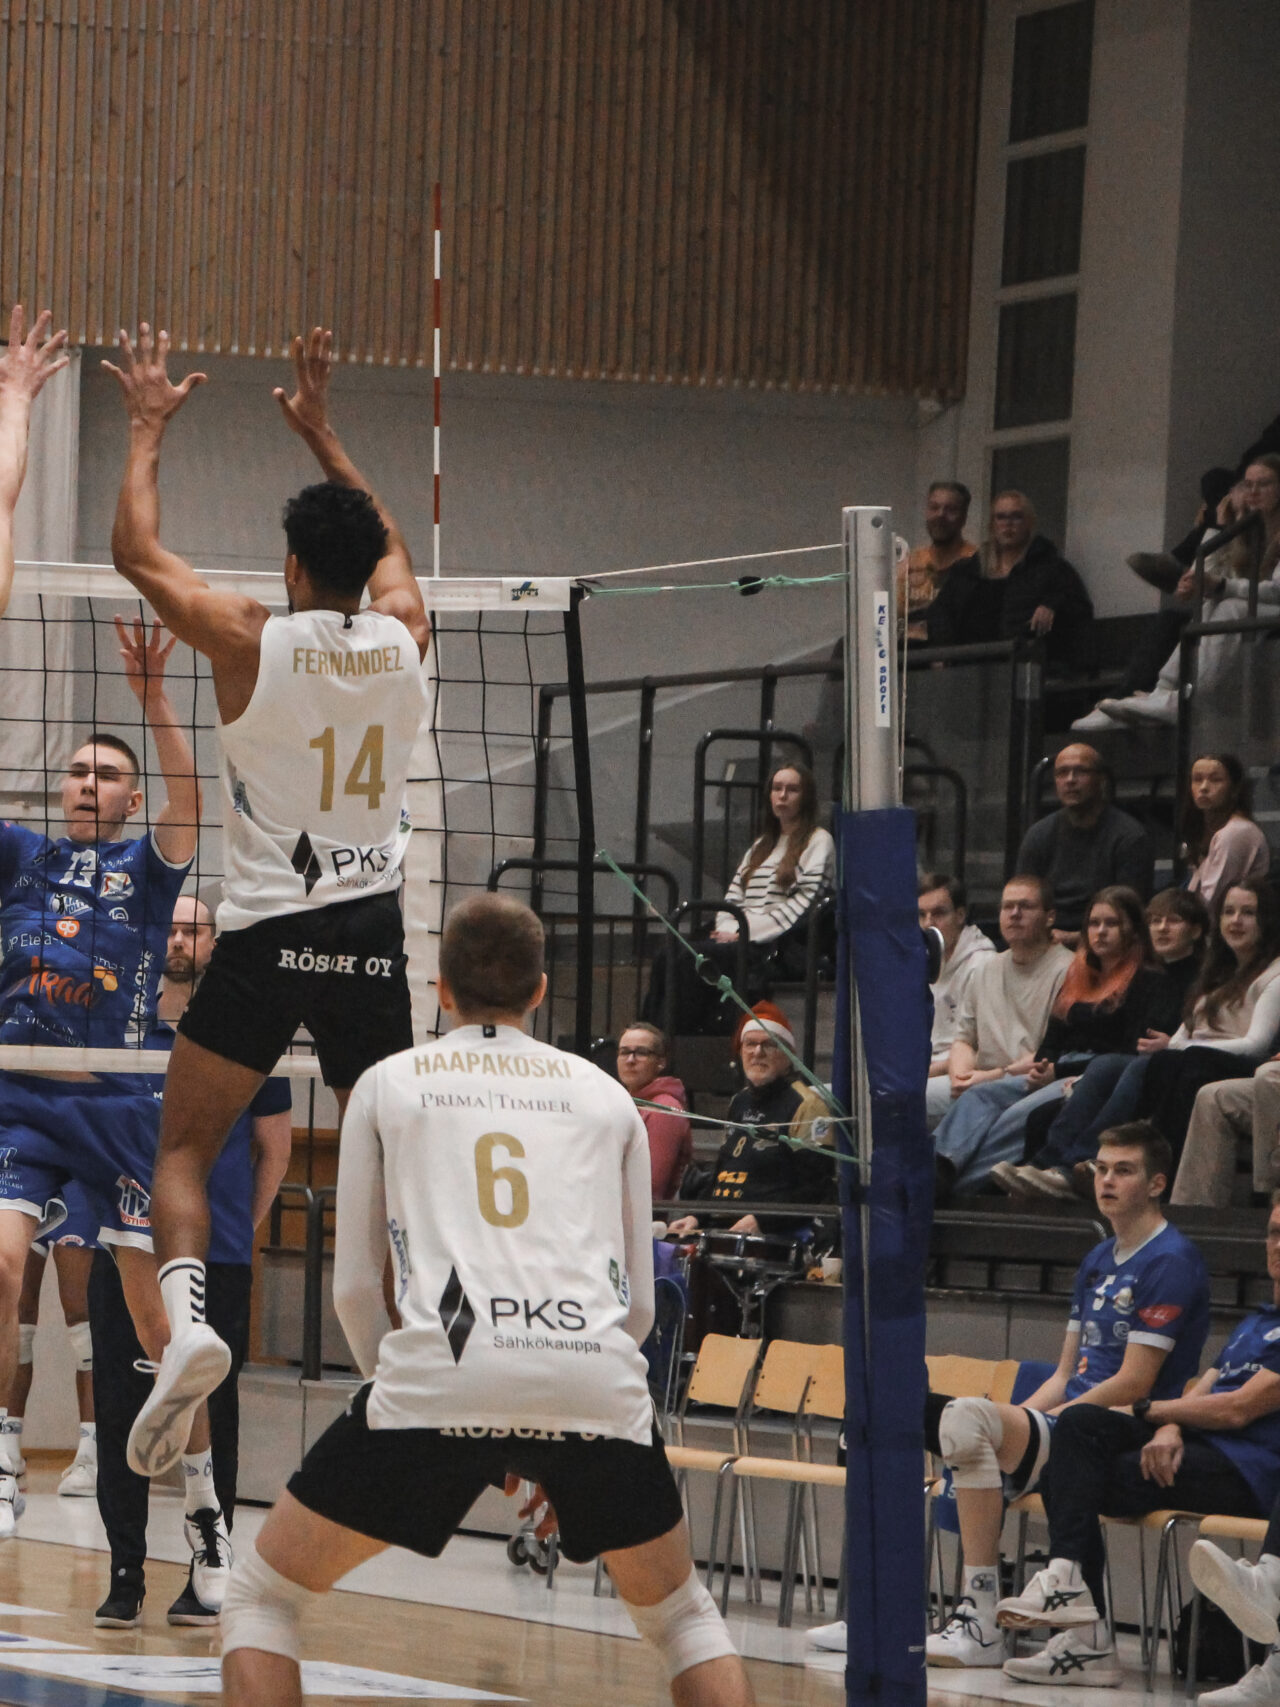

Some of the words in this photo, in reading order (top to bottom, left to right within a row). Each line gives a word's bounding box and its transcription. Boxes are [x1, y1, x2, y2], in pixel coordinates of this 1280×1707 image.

[292, 645, 405, 678] FERNANDEZ
[879, 665, 887, 714] sport
[309, 724, 387, 812] 14
[58, 848, 98, 888] 13
[364, 956, 393, 978] OY
[414, 1051, 573, 1079] HAAPAKOSKI
[474, 1131, 530, 1229] 6
[490, 1297, 588, 1332] PKS
[493, 1334, 603, 1355] Sähkökauppa
